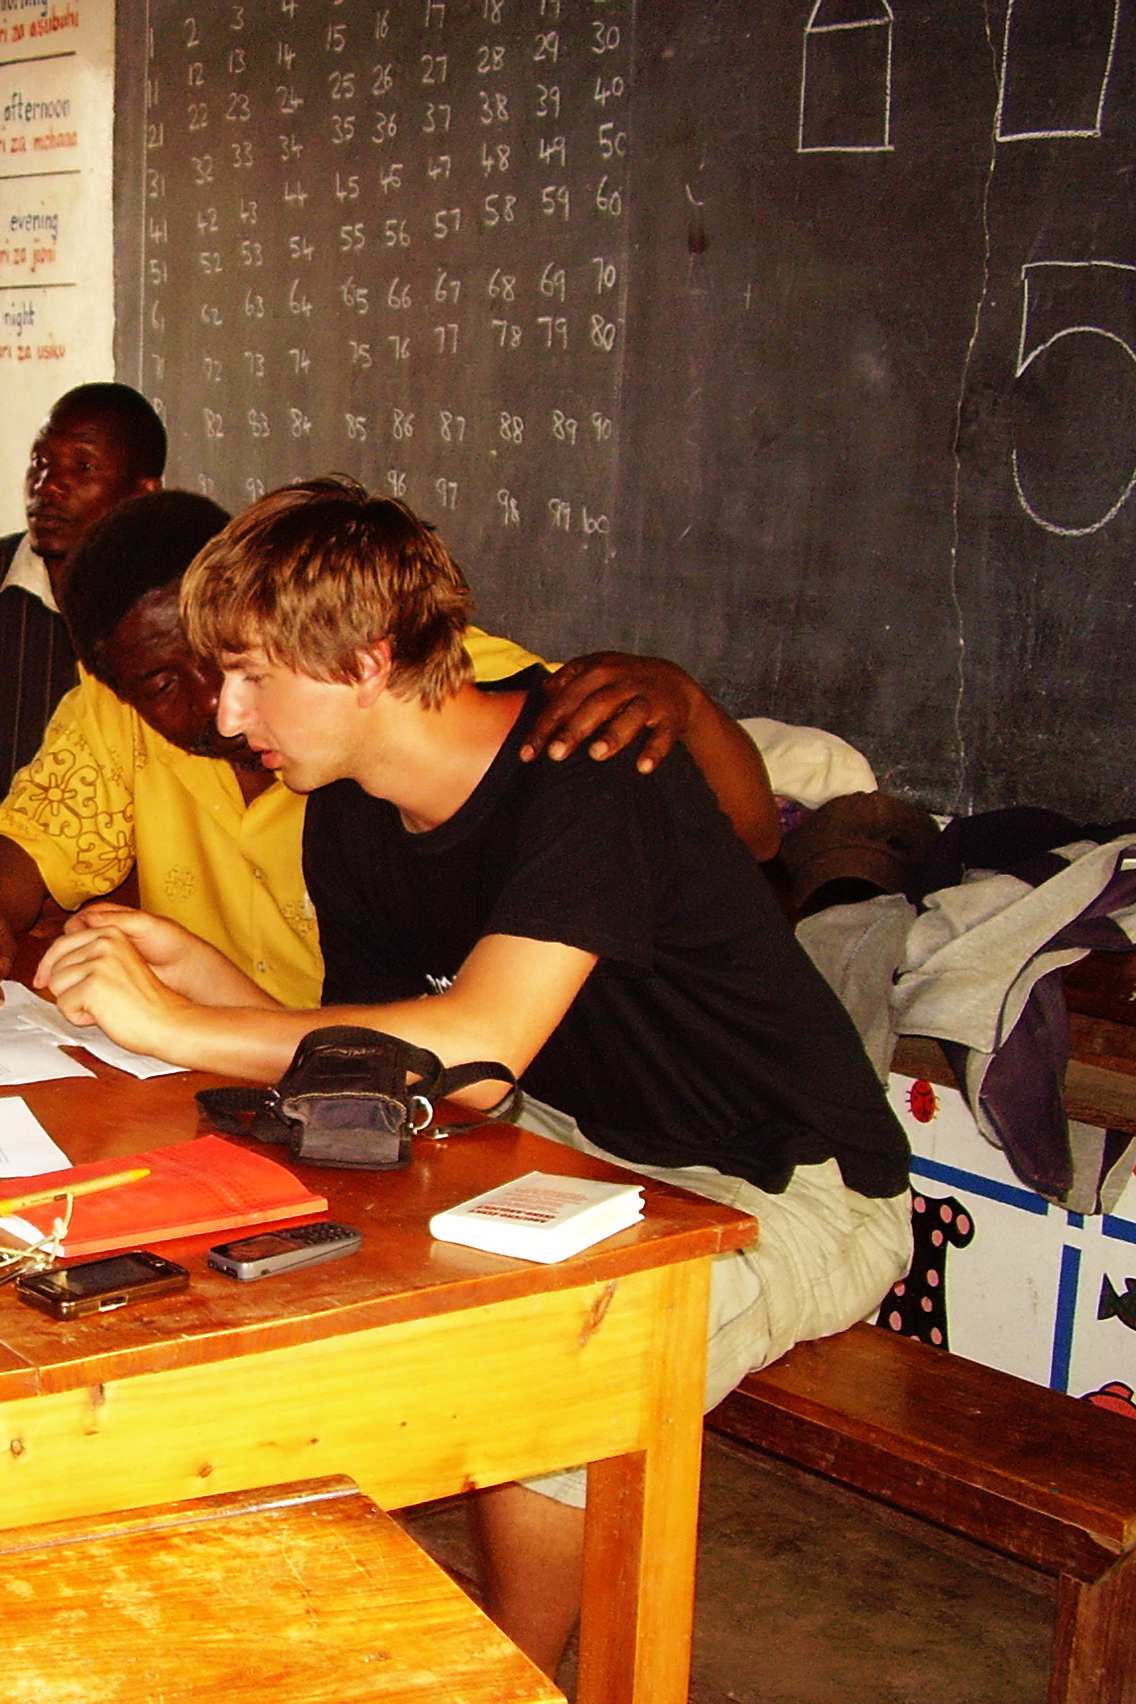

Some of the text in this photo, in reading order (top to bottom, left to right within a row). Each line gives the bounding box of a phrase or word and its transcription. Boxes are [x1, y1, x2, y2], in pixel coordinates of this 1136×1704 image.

[184, 18, 200, 48] 2
[230, 6, 245, 30] 3
[188, 62, 205, 86] 12
[229, 49, 247, 73] 13
[277, 42, 296, 70] 14
[326, 24, 348, 52] 15
[375, 10, 390, 40] 16
[424, 0, 446, 28] 17
[483, 0, 502, 24] 18
[4, 91, 70, 121] afternoon
[148, 21, 620, 148] 21 22 23 24 25 26 27 28 29 30
[147, 76, 624, 198] 31 32 33 34 35 36 37 38 39 40
[150, 217, 167, 244] 41
[197, 208, 219, 236] 42
[240, 199, 257, 225] 43
[284, 181, 308, 208] 44
[335, 172, 360, 204] 45
[427, 156, 451, 181] 47
[482, 144, 511, 177] 48
[539, 136, 566, 167] 49
[10, 208, 59, 245] evening
[149, 175, 622, 285] 51 52 53 54 55 56 57 58 59 60
[4, 302, 35, 337] night
[201, 303, 223, 326] 62
[244, 288, 265, 318] 63
[289, 278, 313, 318] 64
[341, 276, 369, 315] 65
[387, 277, 412, 308] 66
[434, 271, 461, 302] 67
[488, 268, 516, 302] 68
[540, 262, 566, 302] 69
[592, 257, 616, 294] 70
[243, 352, 265, 377] 73
[289, 350, 312, 375] 74
[348, 341, 373, 369] 75
[388, 336, 411, 359] 76
[434, 324, 459, 353] 77
[491, 319, 523, 348] 78
[537, 316, 568, 350] 79
[590, 314, 616, 351] 80
[290, 408, 312, 438] 84
[345, 413, 368, 441] 85
[393, 408, 415, 440] 86
[440, 411, 466, 441] 87
[499, 412, 525, 444] 88
[552, 410, 578, 445] 89
[591, 412, 612, 441] 90
[387, 470, 407, 497] 96
[435, 478, 459, 510] 97
[497, 488, 520, 526] 98
[548, 498, 572, 532] 99
